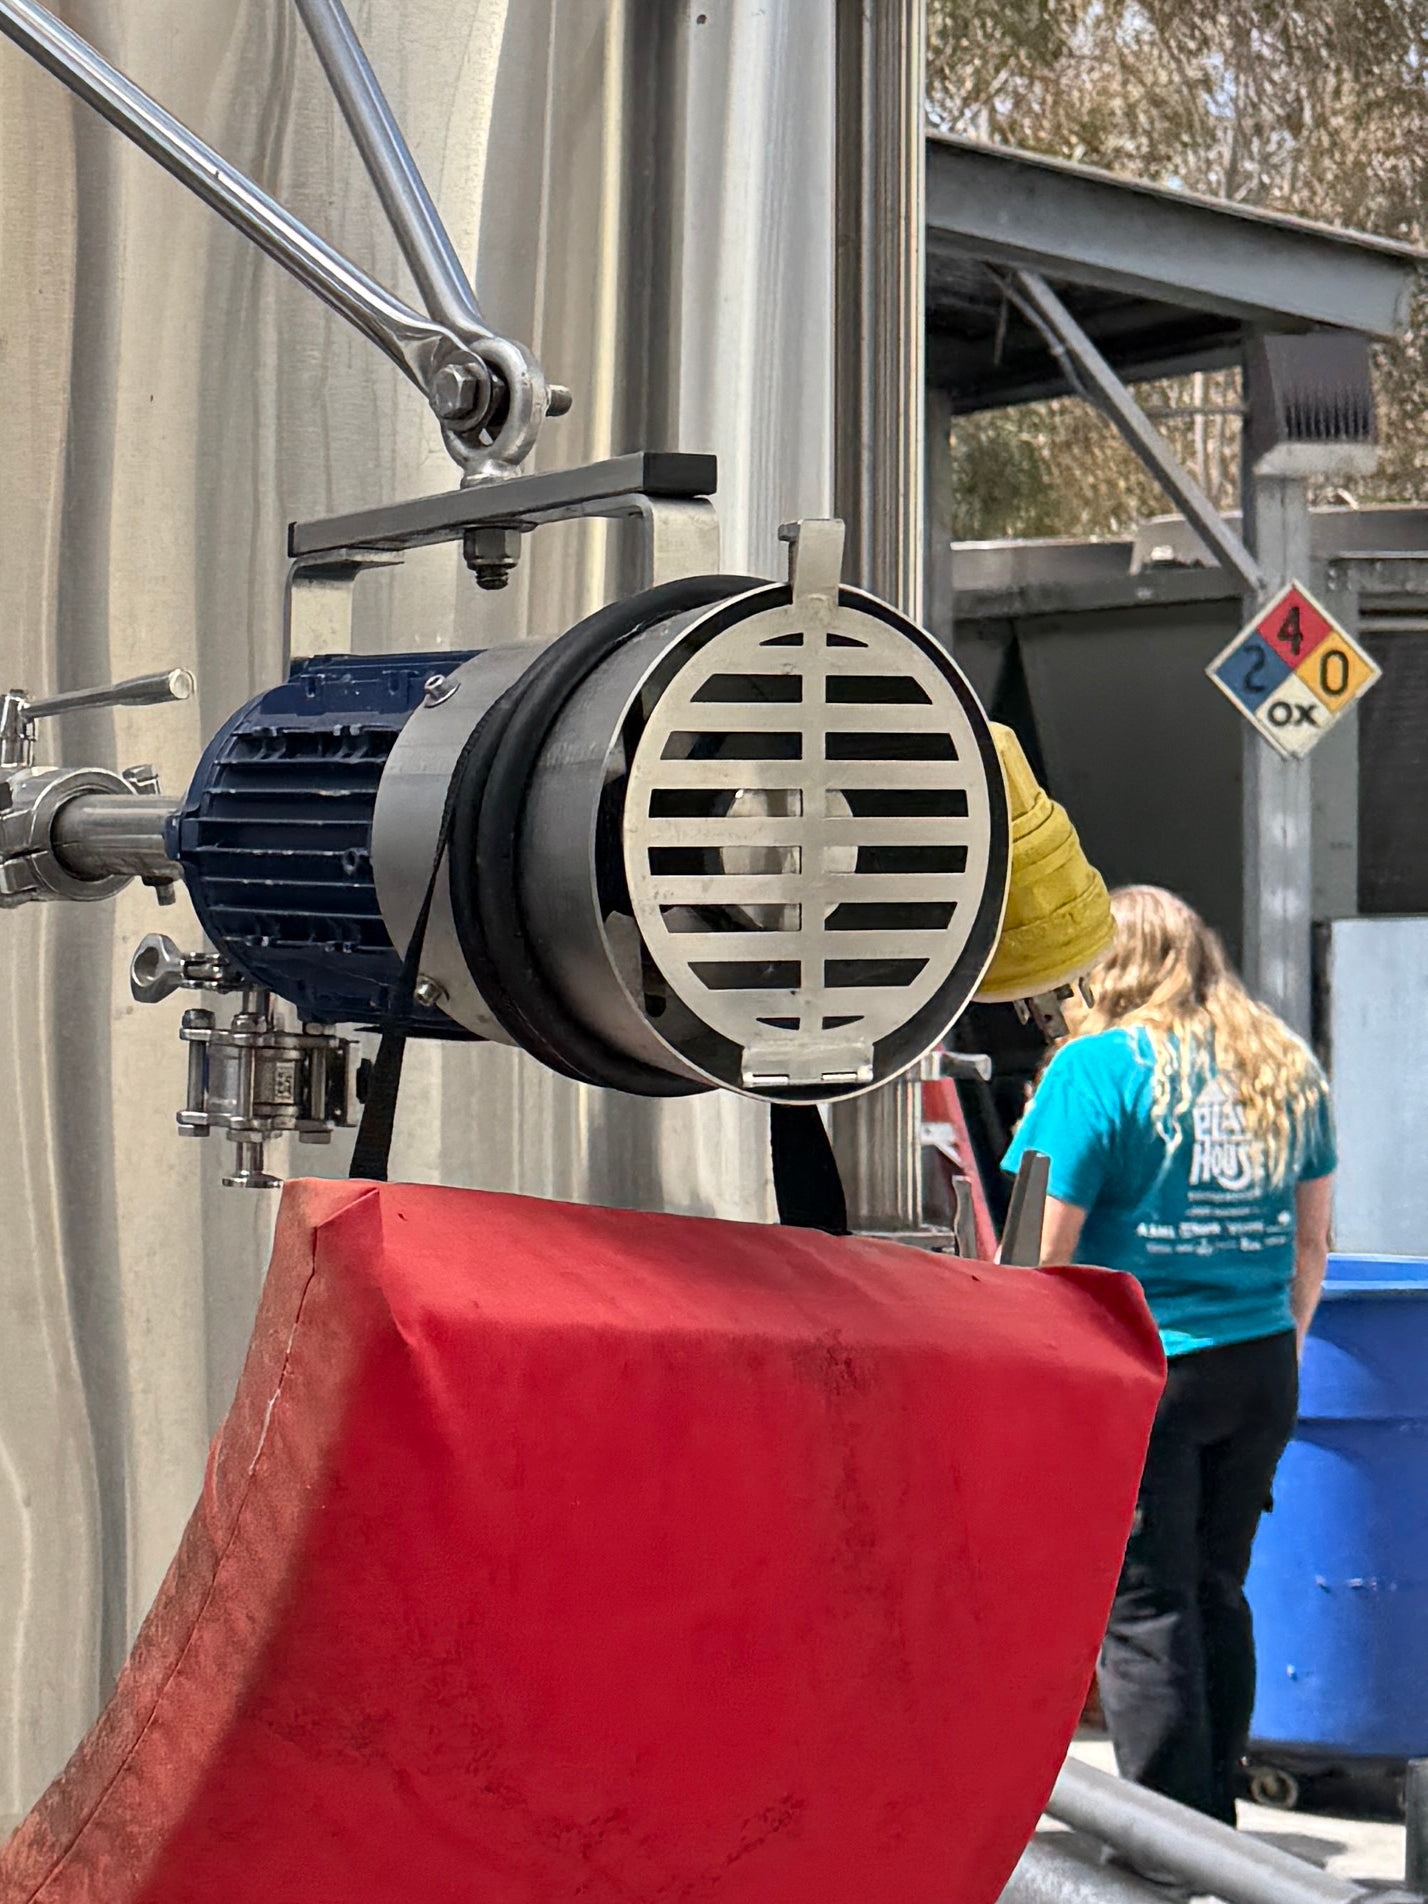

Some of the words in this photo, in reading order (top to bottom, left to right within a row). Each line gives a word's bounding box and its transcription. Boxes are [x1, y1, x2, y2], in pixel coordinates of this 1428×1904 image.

[1276, 605, 1303, 656] 4
[1244, 643, 1267, 694] 2
[1319, 649, 1349, 697] 0
[1266, 700, 1321, 728] OX
